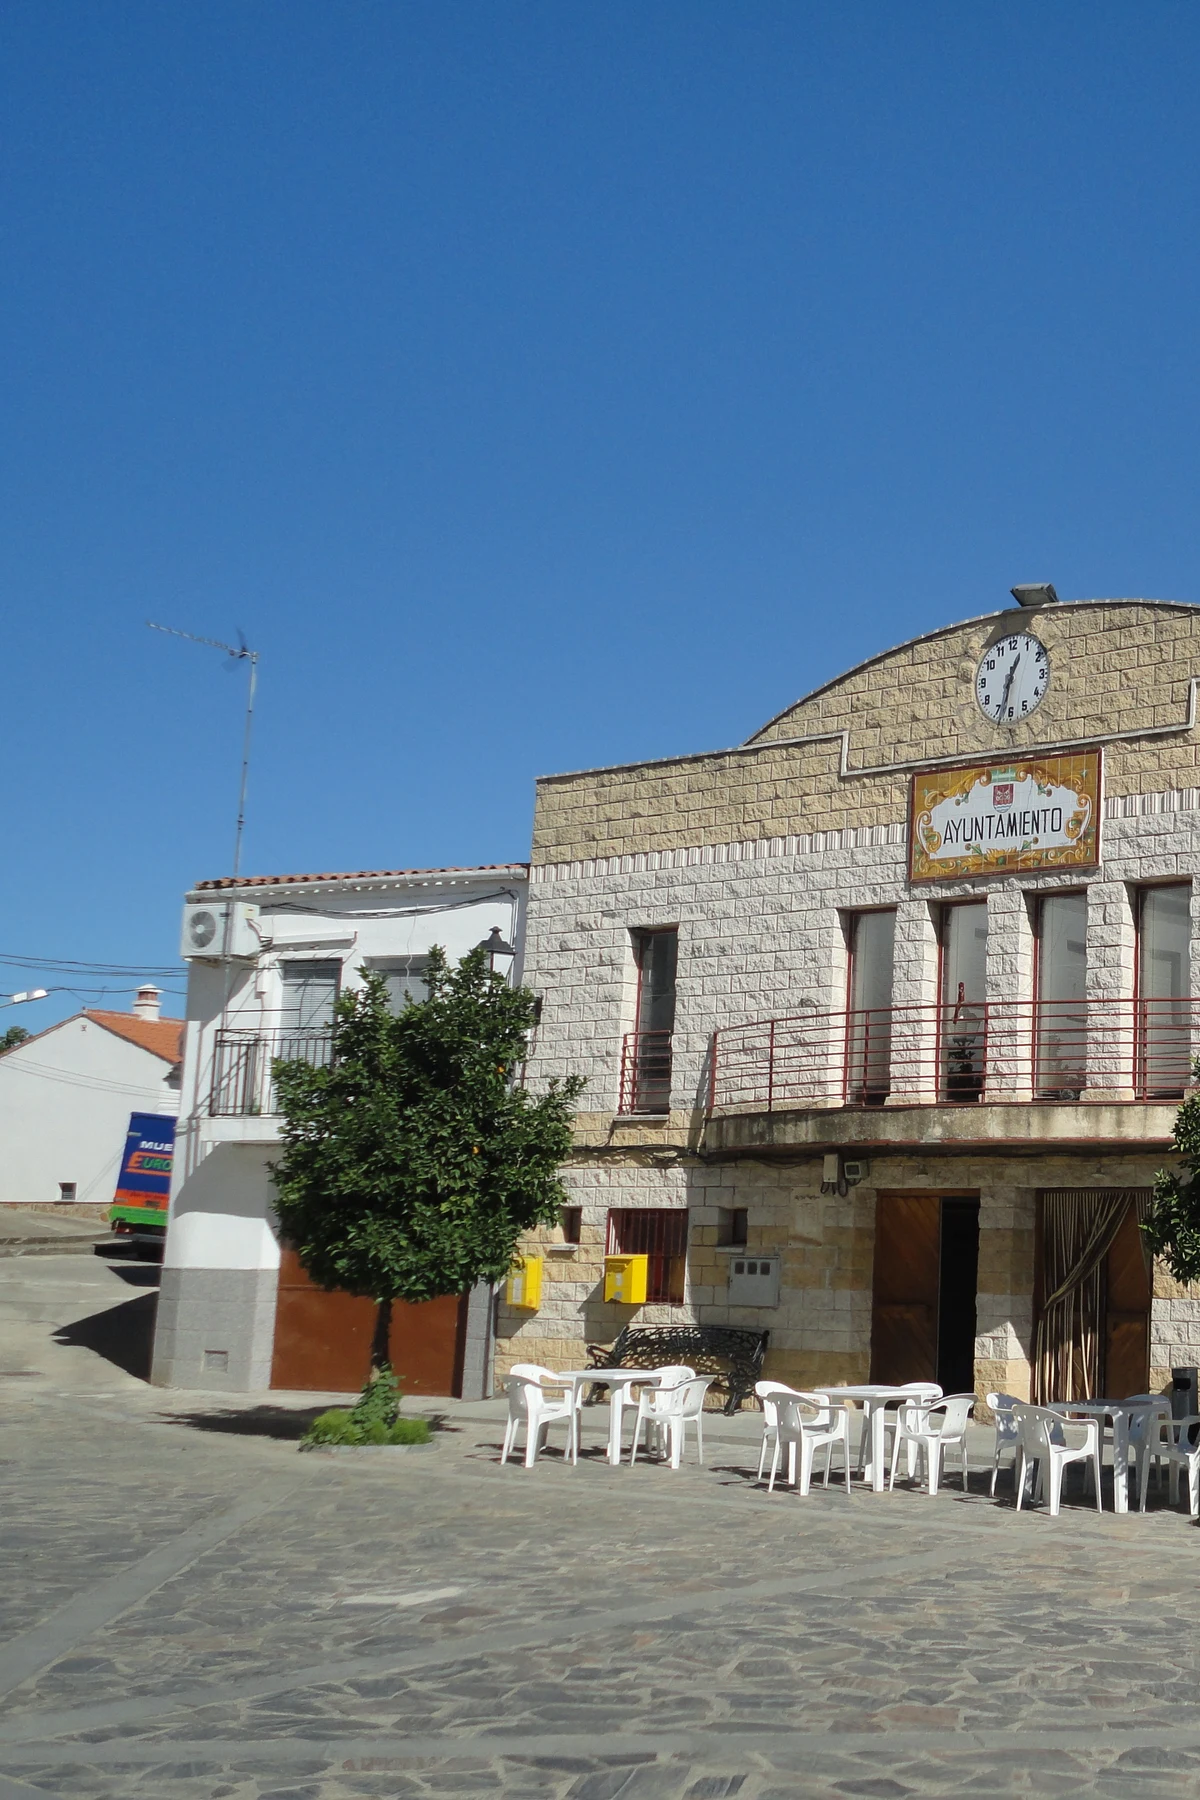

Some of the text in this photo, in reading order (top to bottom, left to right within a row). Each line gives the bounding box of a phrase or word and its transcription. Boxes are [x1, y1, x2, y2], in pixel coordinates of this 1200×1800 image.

[1008, 639, 1018, 651] 12
[1025, 640, 1030, 652] 1
[996, 646, 1005, 658] 11
[1035, 652, 1041, 663] 2
[986, 659, 996, 671] 10
[1039, 668, 1045, 680] 3
[981, 678, 986, 688] 9
[1034, 687, 1039, 697] 4
[985, 695, 990, 705] 8
[1022, 700, 1028, 711] 5
[996, 705, 1001, 715] 7
[1008, 707, 1014, 717] 6
[942, 807, 1063, 845] AYUNTAMIENTO
